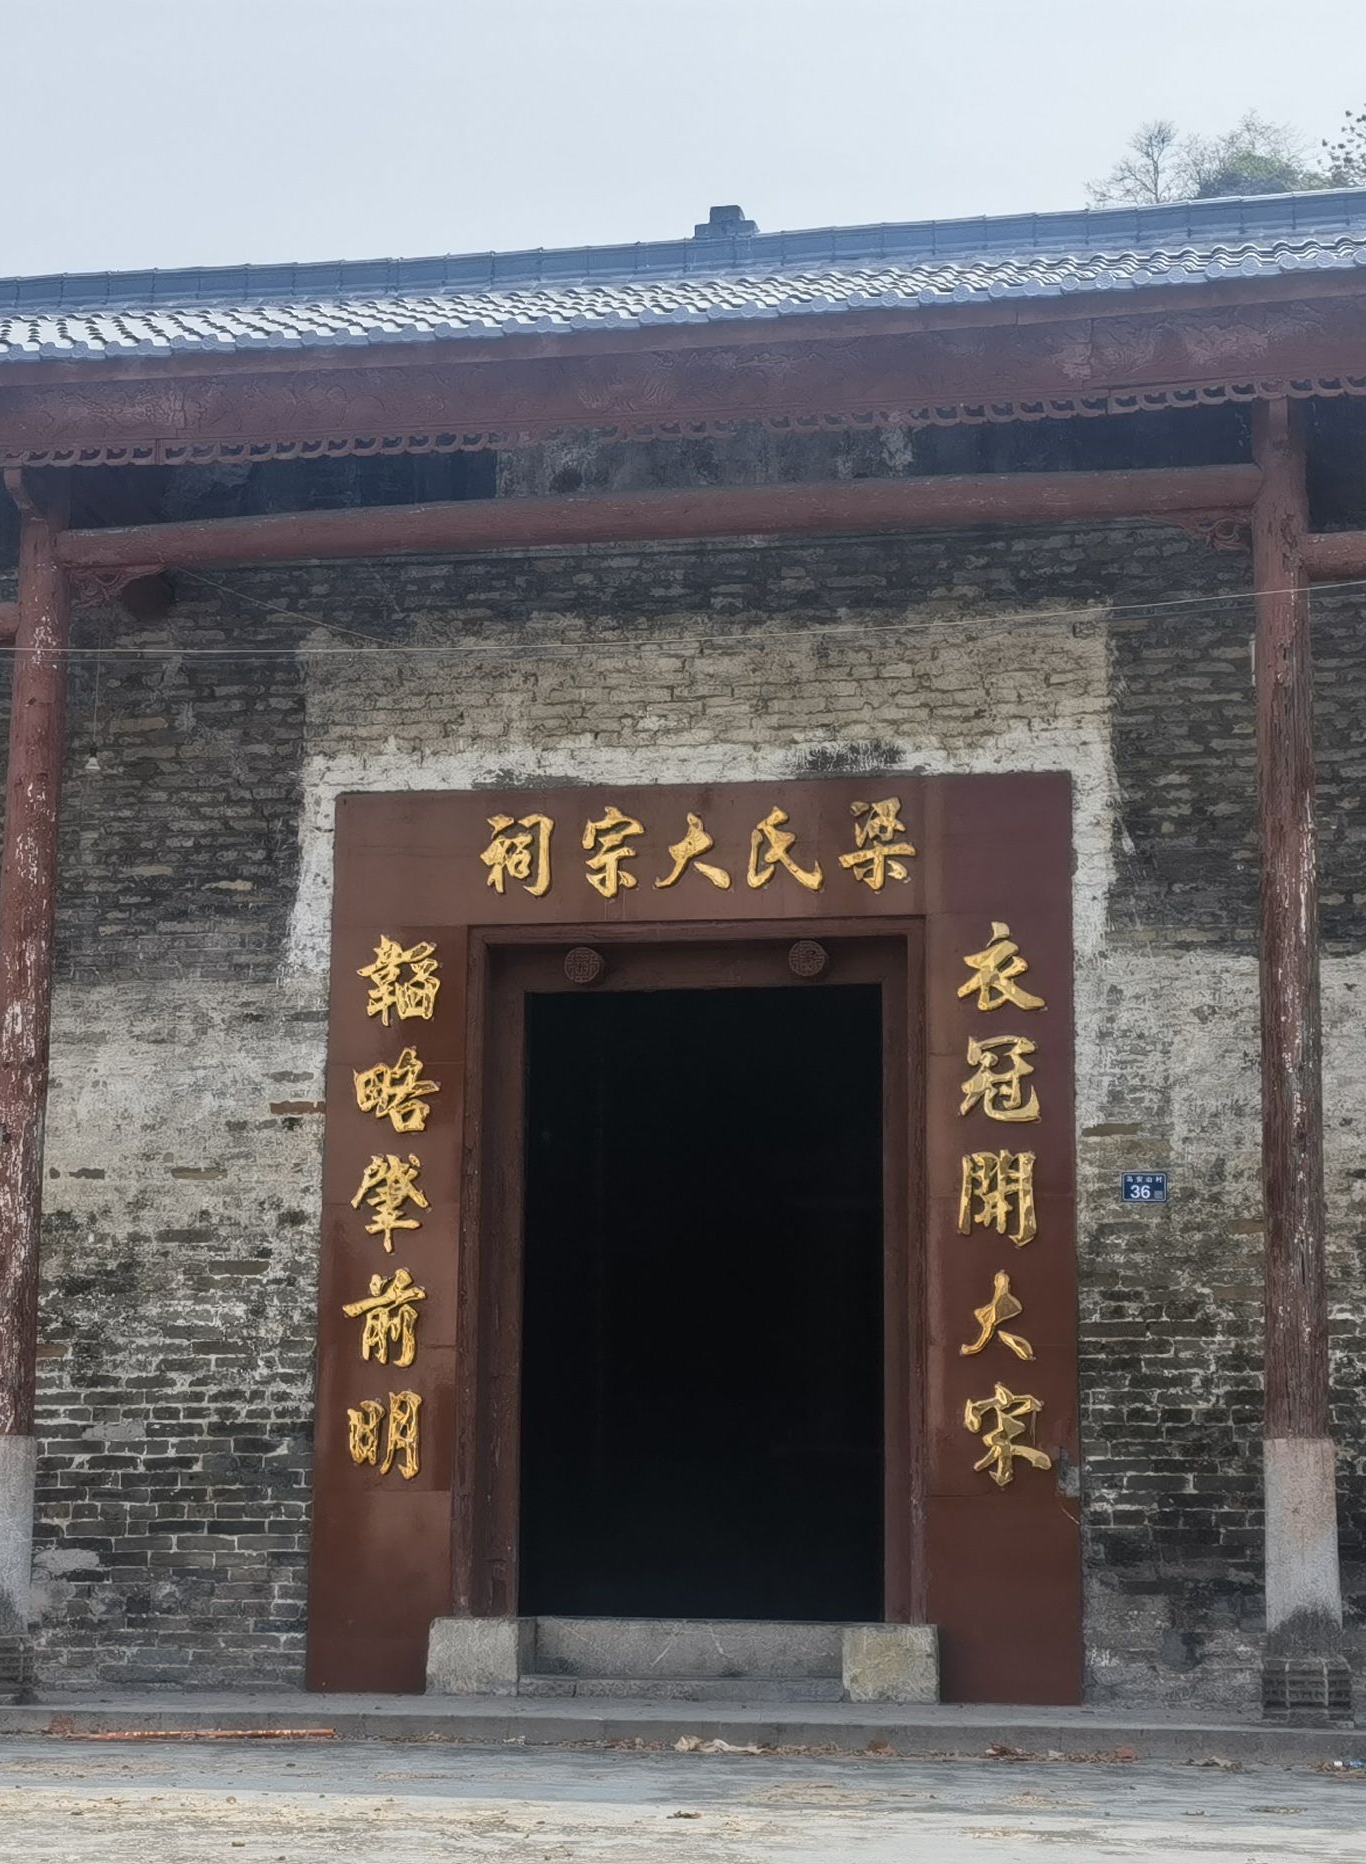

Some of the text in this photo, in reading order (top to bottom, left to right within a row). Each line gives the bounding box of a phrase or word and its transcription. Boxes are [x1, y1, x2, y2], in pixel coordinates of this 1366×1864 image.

[478, 796, 917, 900] 梁氏大宗祠
[956, 920, 1053, 1488] 衣冠開大宋
[1130, 1184, 1151, 1199] 36
